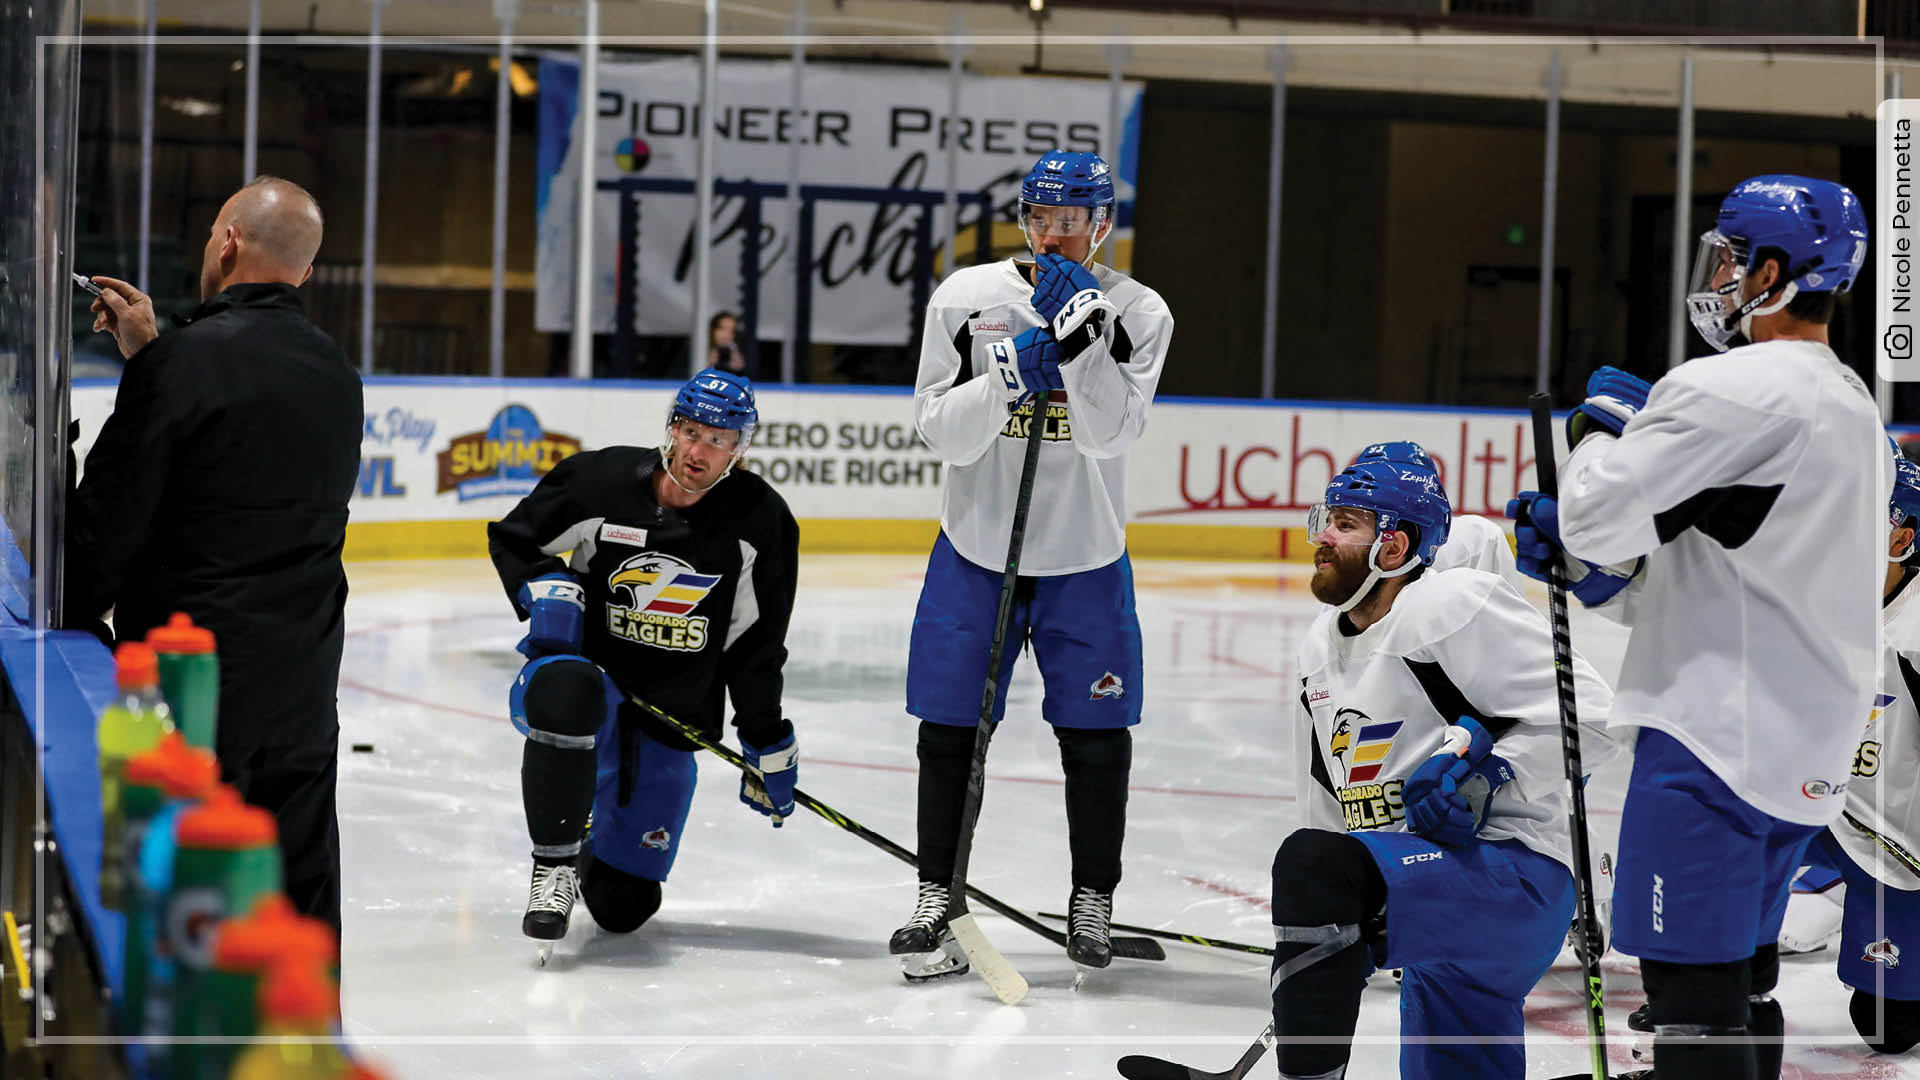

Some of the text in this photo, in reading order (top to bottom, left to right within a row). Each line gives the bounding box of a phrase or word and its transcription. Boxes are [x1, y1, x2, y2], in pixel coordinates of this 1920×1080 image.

[597, 91, 1099, 153] PIONEER PRESS
[1036, 181, 1064, 190] CCM
[1741, 290, 1769, 315] CCM
[974, 320, 1009, 332] uchealth
[992, 343, 1021, 392] CC
[708, 380, 728, 392] 67
[697, 402, 723, 414] CCM
[751, 422, 927, 452] ZERO SUGA
[846, 459, 942, 486] RIGHT
[608, 608, 706, 650] EAGLES
[626, 611, 688, 627] COLORADO
[1341, 784, 1383, 802] COLORADO
[1343, 780, 1405, 830] AGLES
[1402, 851, 1443, 865] CCM
[1652, 873, 1664, 934] CCM
